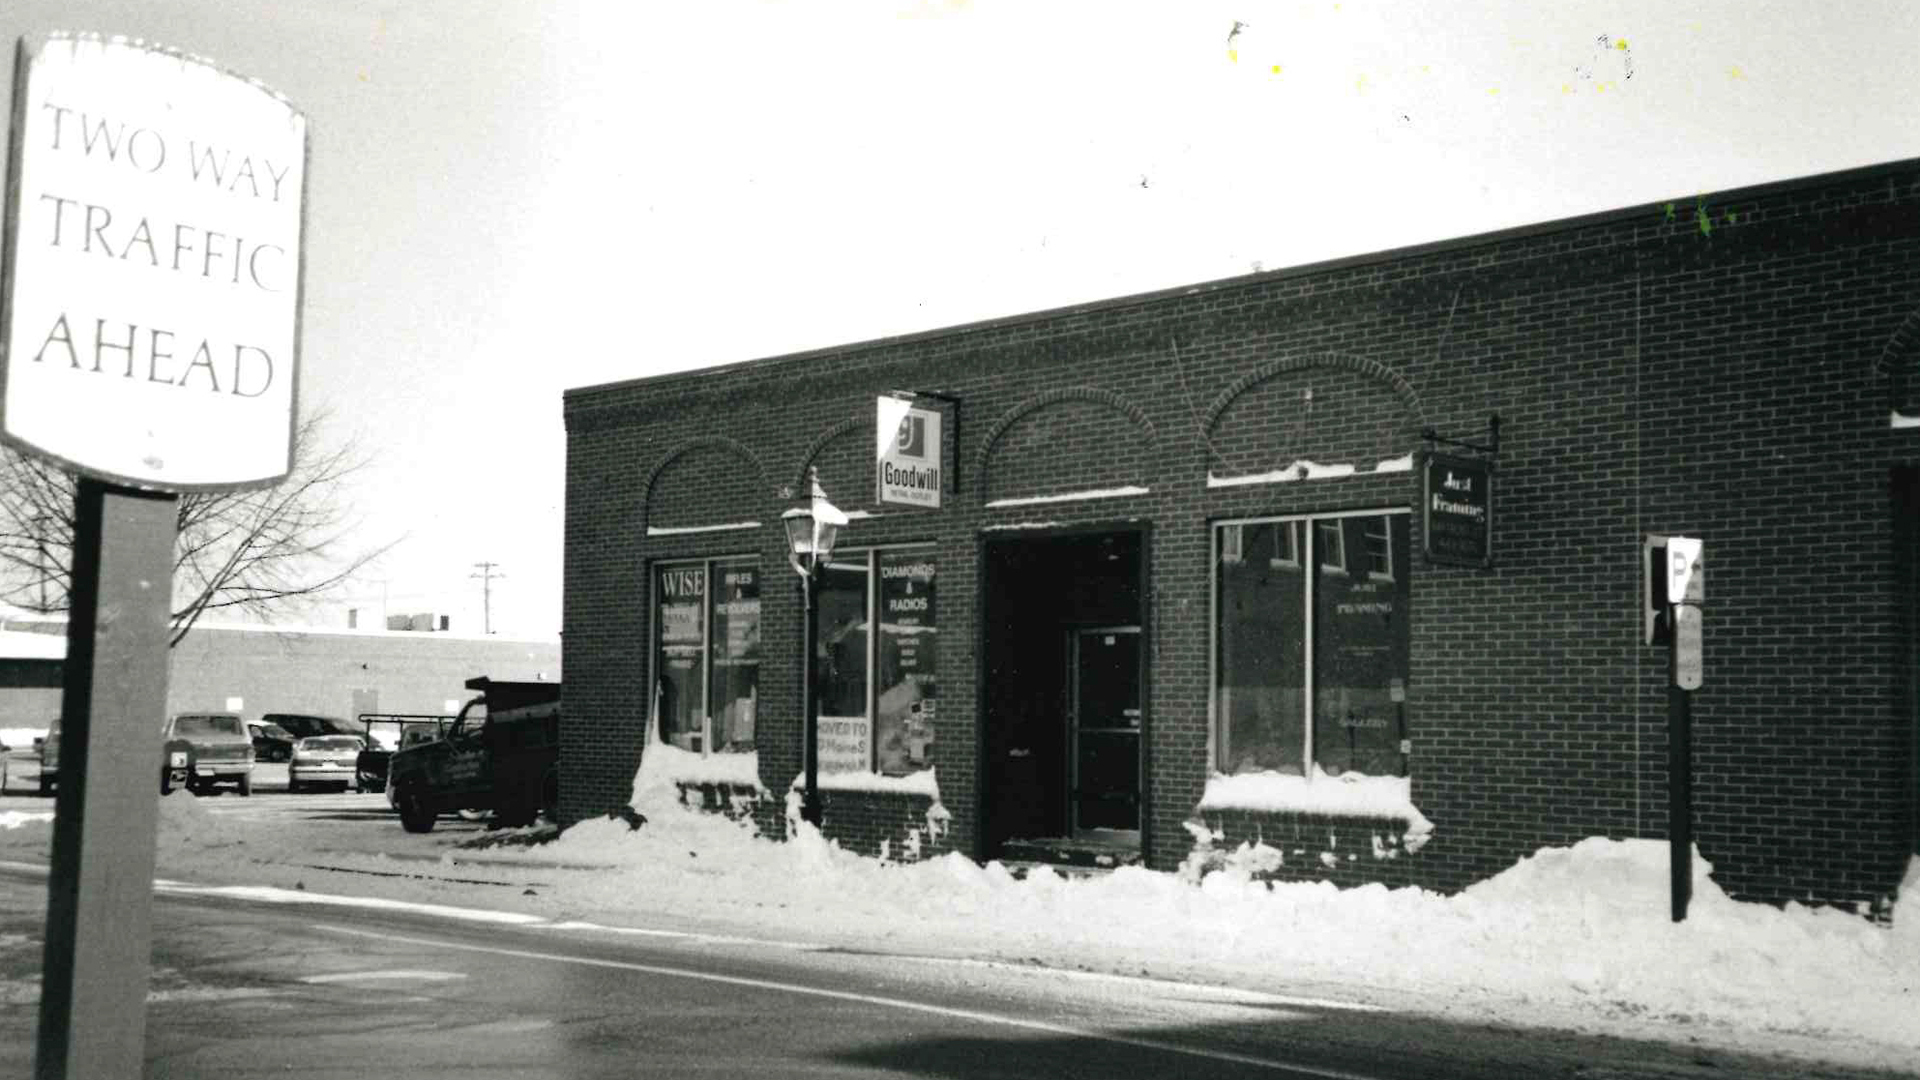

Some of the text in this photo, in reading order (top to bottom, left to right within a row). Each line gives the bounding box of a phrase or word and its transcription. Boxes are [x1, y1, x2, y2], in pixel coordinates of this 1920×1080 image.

[43, 102, 290, 202] TWO WAY
[40, 193, 286, 293] TRAFFIC
[33, 313, 274, 399] AHEAD
[884, 461, 938, 491] Goodwill
[1443, 471, 1471, 492] Just
[1433, 492, 1485, 523] Framing
[662, 570, 704, 597] WISE
[726, 573, 752, 585] FLES
[881, 563, 935, 579] DIAMONDS
[1672, 551, 1687, 589] P
[889, 598, 928, 611] RADIOS
[853, 723, 868, 737] TO
